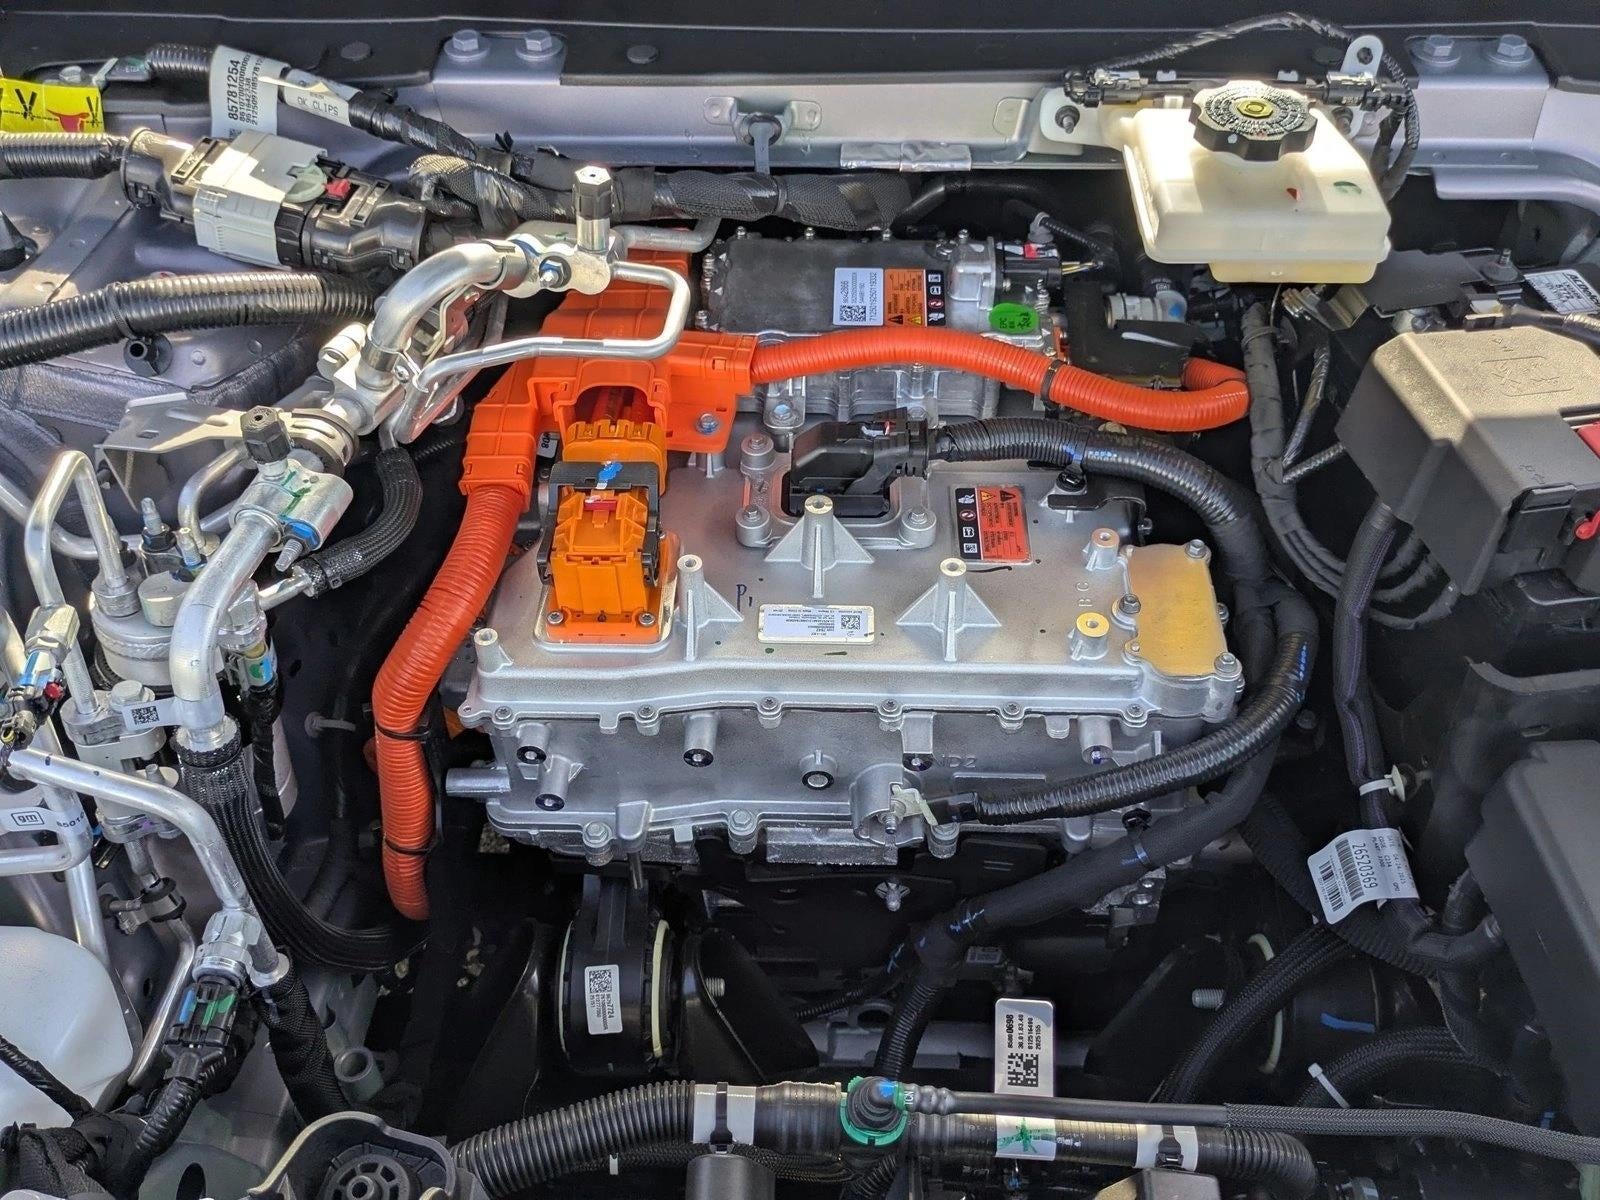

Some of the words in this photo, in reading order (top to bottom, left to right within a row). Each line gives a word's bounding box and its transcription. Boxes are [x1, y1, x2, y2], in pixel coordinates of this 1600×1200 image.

[226, 59, 241, 121] 85781254
[312, 100, 339, 117] CLIPS
[17, 814, 39, 823] gm
[1352, 843, 1379, 889] 26520369
